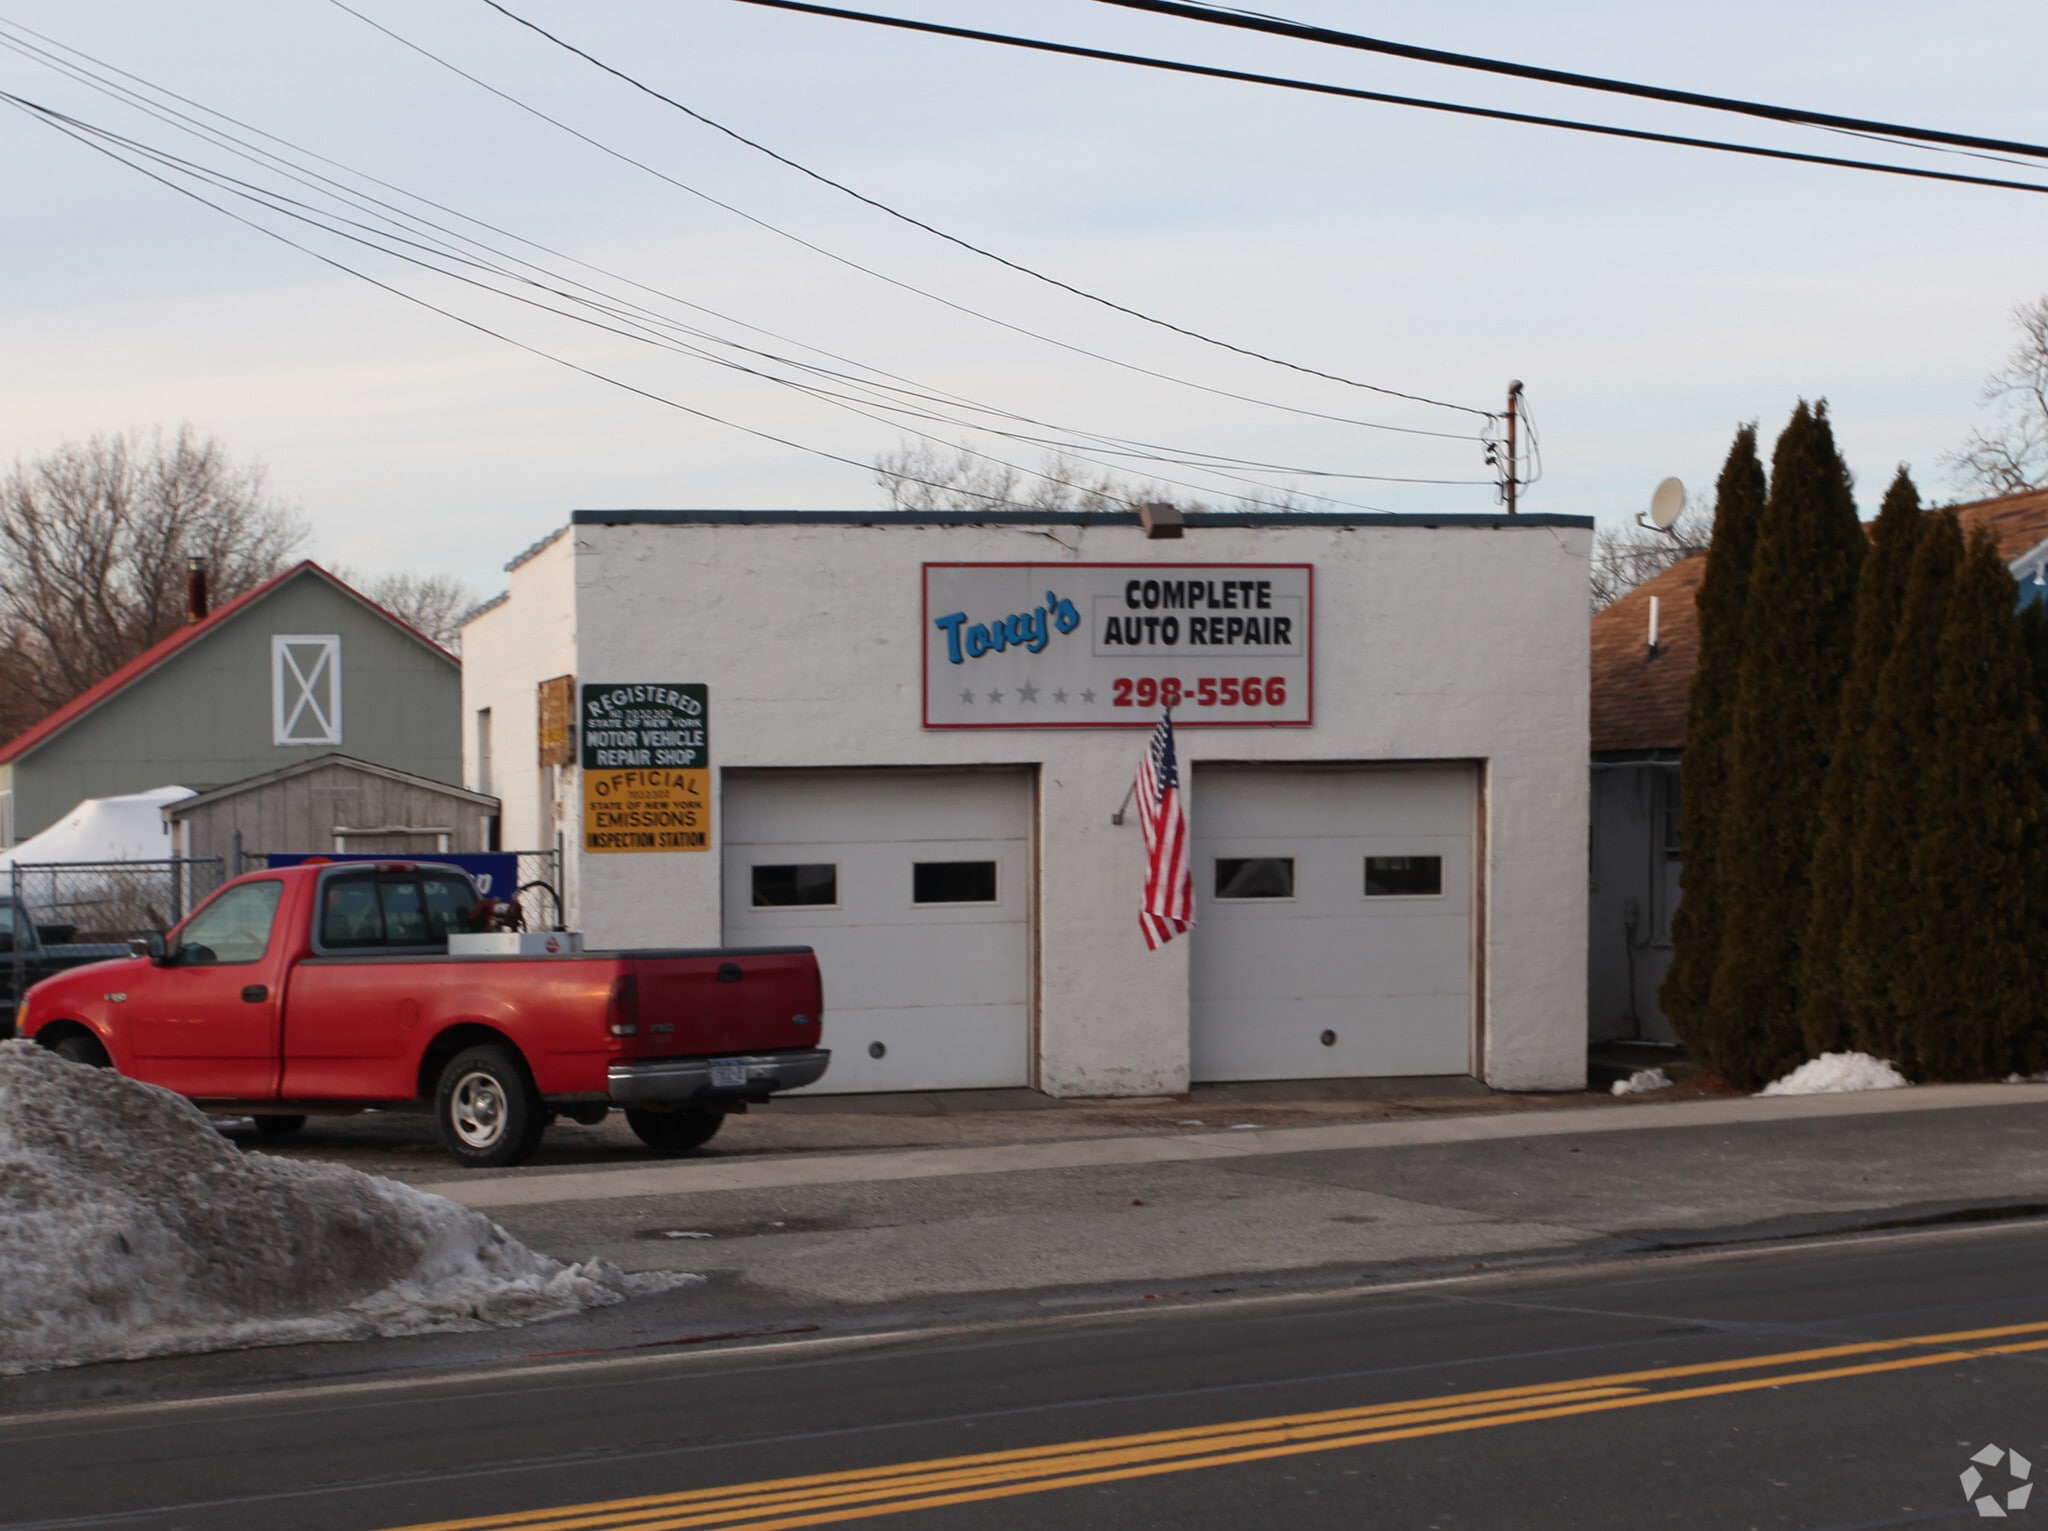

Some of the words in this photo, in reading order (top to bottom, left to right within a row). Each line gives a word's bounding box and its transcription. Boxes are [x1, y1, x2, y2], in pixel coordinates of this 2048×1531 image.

[1125, 579, 1272, 610] COMPLETE
[935, 589, 1080, 665] Tony's
[1103, 616, 1180, 646] AUTO
[1188, 616, 1293, 646] REPAIR
[588, 686, 702, 716] REGISTERED
[1112, 676, 1287, 707] 298-5566
[587, 719, 622, 728] STATE
[624, 718, 640, 728] OF
[642, 719, 669, 728] NEW
[672, 718, 702, 728] YORK
[586, 730, 638, 747] MOTOR
[640, 730, 704, 747] VEHICLE
[597, 749, 651, 766] REPAIR
[655, 749, 696, 766] SHOP
[595, 771, 699, 796] OFFICIAL
[589, 801, 623, 810] STATE
[626, 801, 641, 810] OF
[644, 801, 669, 809] NEW
[673, 800, 702, 809] YORK
[596, 811, 697, 828] EMISSIONS
[587, 832, 655, 848] INSPECTION
[659, 831, 706, 847] STATION
